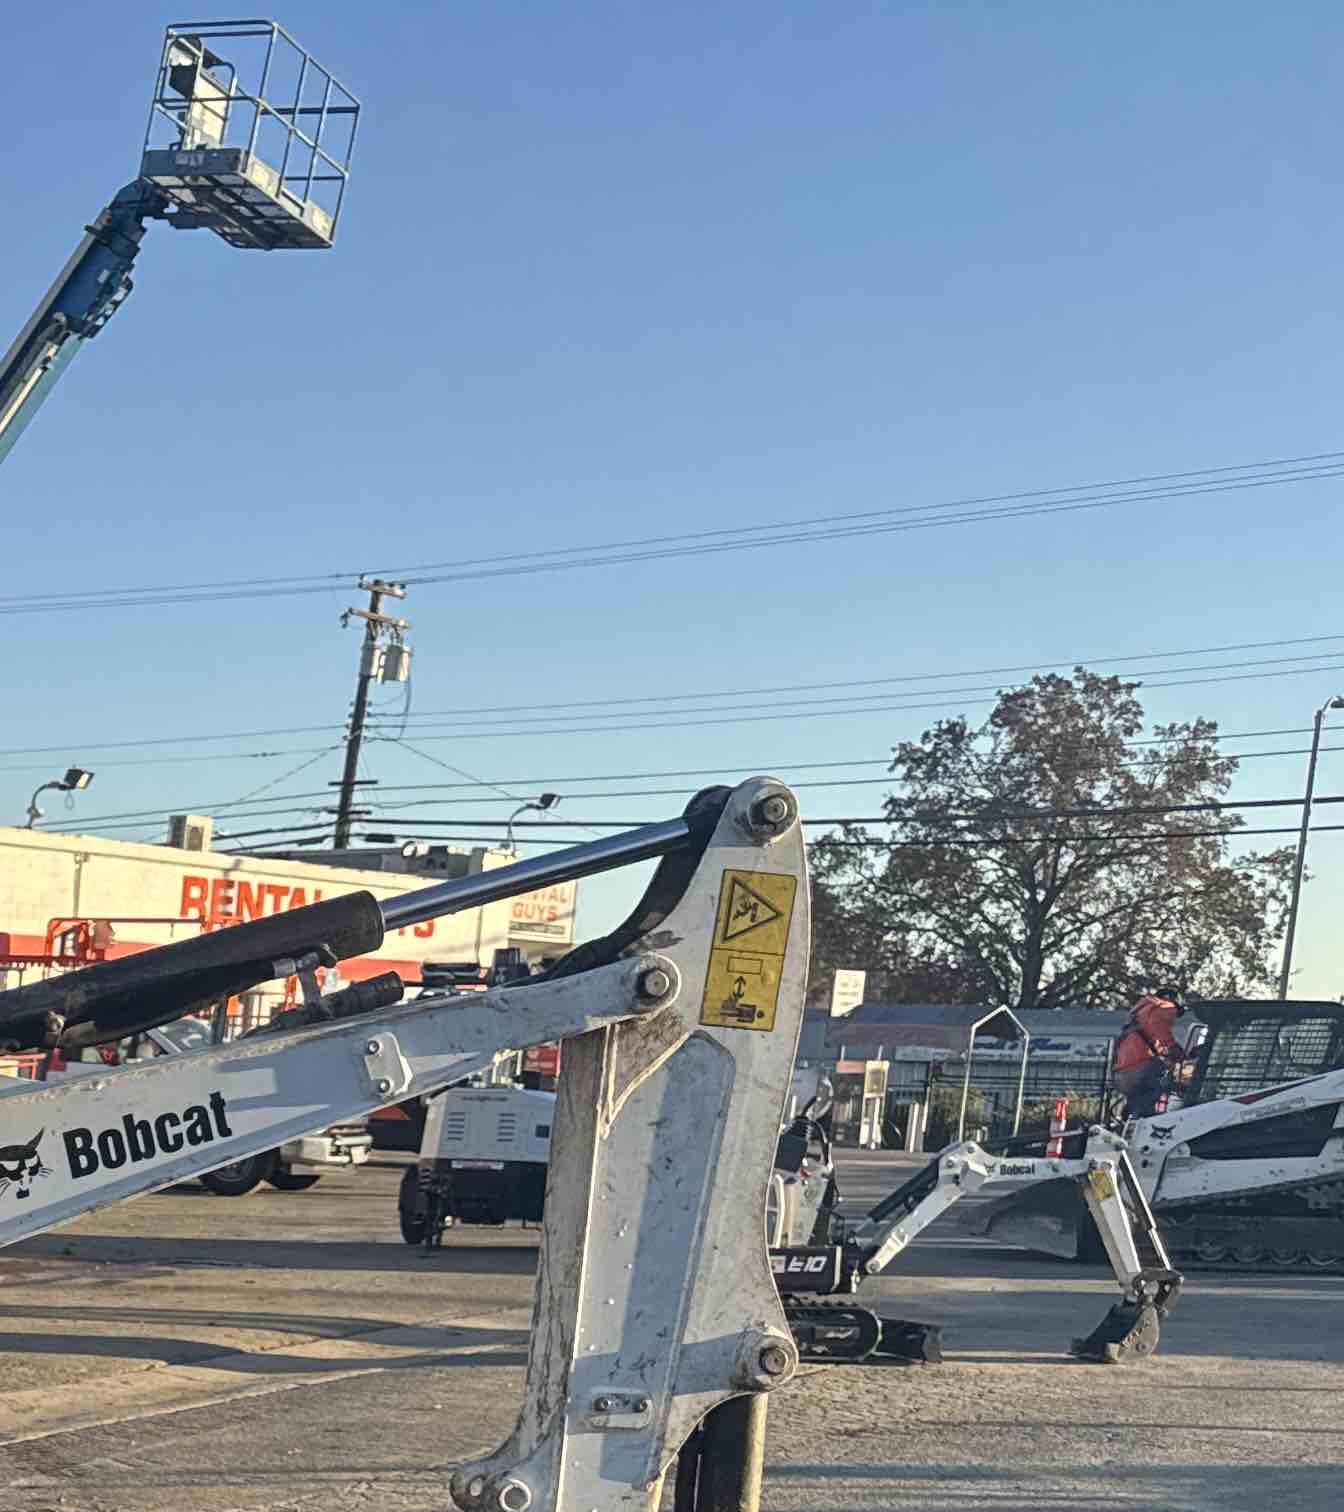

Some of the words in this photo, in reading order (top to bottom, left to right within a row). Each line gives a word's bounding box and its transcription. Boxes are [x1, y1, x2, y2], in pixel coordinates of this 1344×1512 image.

[180, 875, 321, 919] RENTA
[512, 902, 558, 921] GUYS
[63, 1091, 232, 1179] Bobcat
